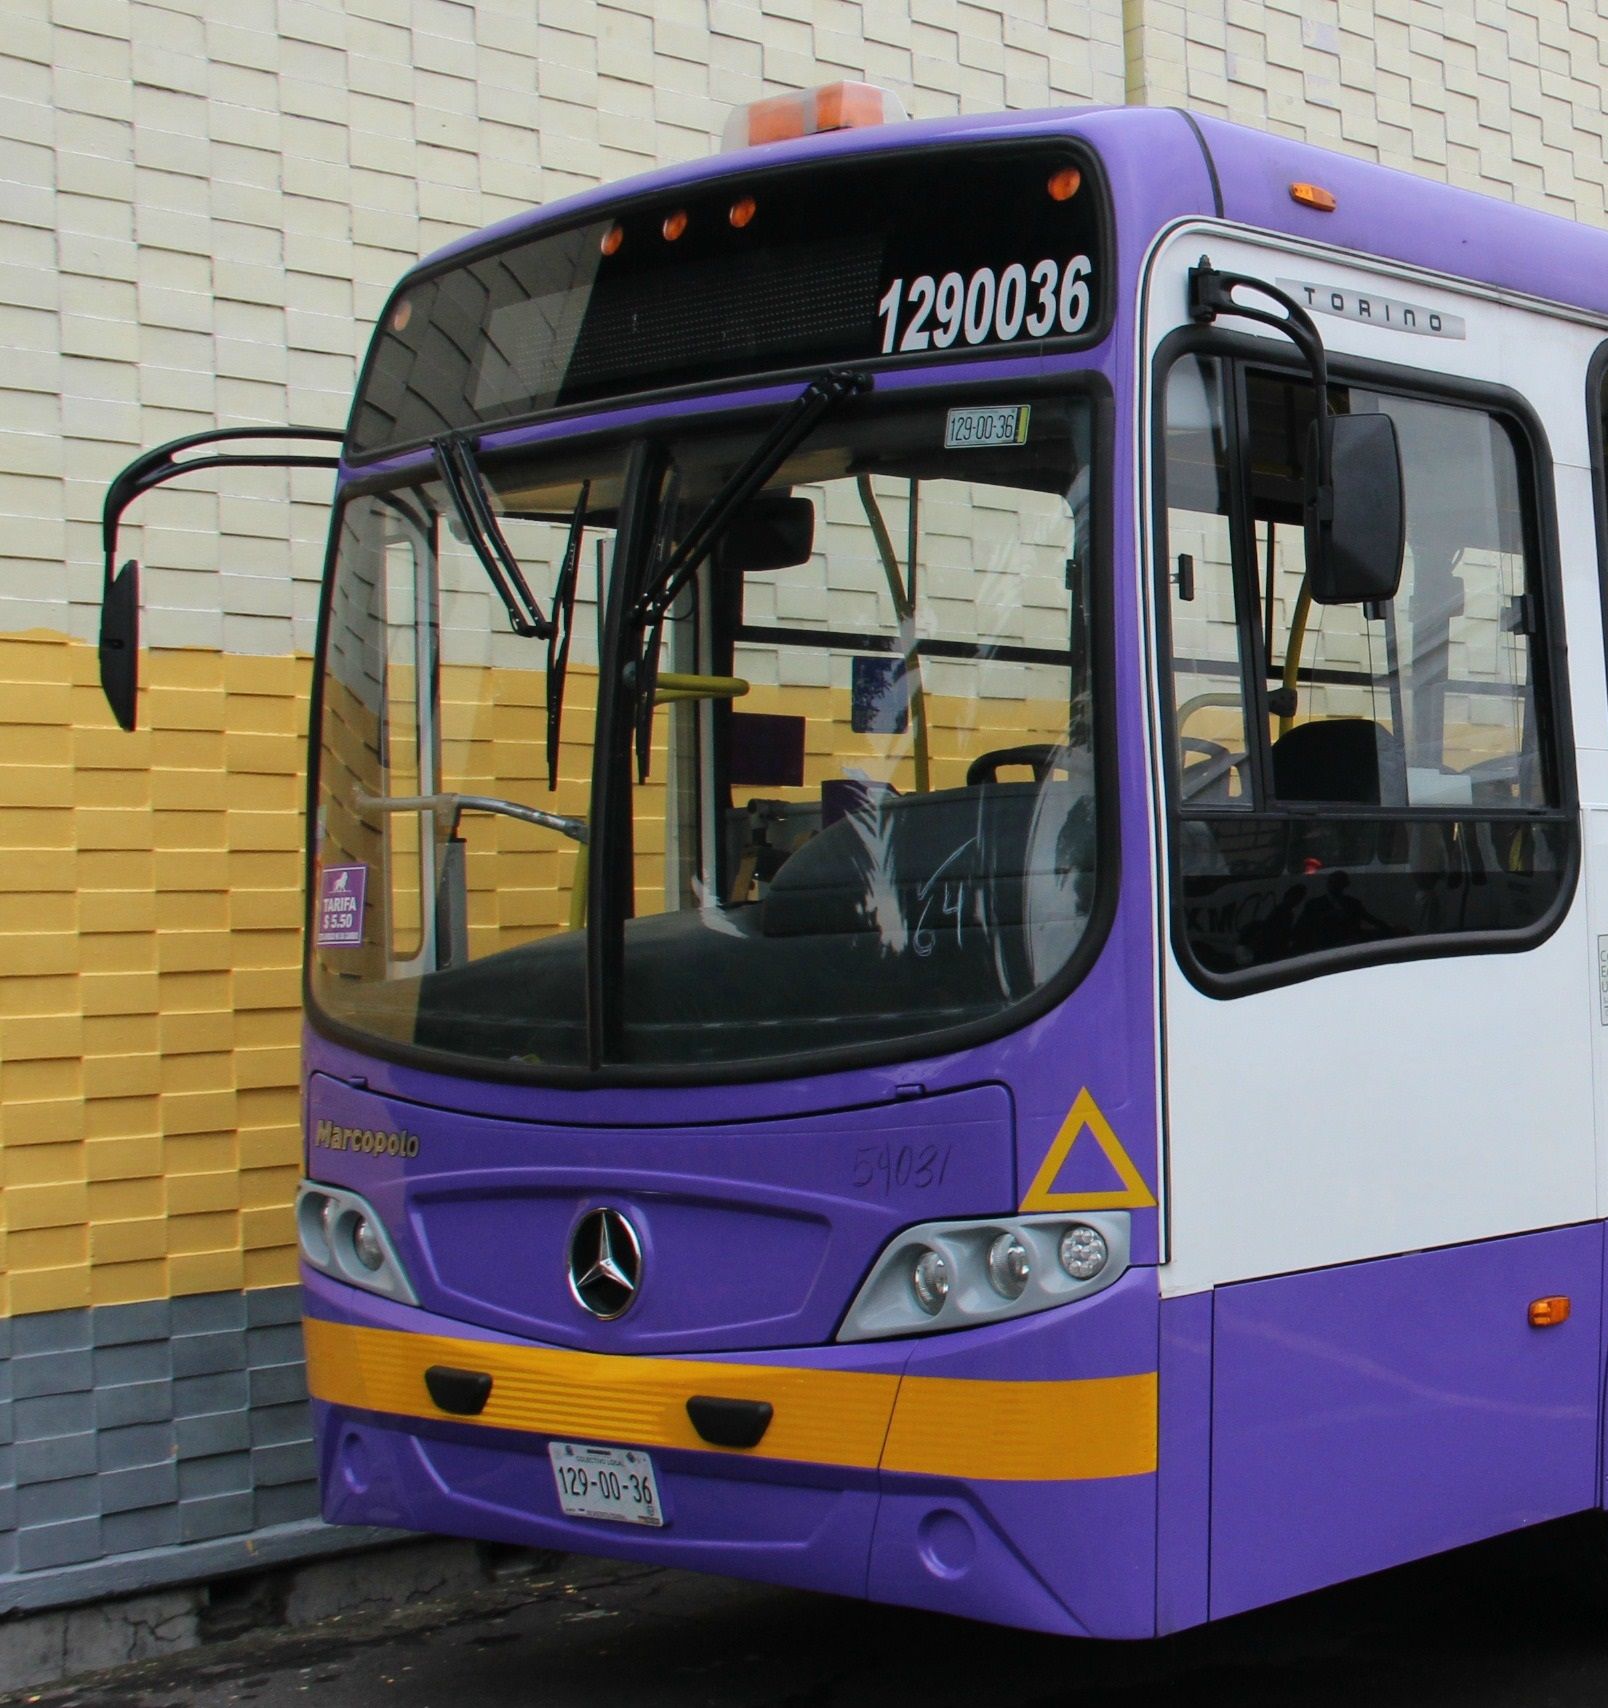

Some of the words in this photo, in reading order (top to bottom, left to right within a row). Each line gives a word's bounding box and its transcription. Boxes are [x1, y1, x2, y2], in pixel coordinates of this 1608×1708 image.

[879, 254, 1092, 354] 1290036
[1303, 286, 1442, 332] TORINO
[950, 414, 1015, 442] 129-00-36
[323, 896, 357, 912] TARIFA
[315, 1118, 420, 1158] Marcopolo
[558, 1465, 653, 1505] 129-00-36
